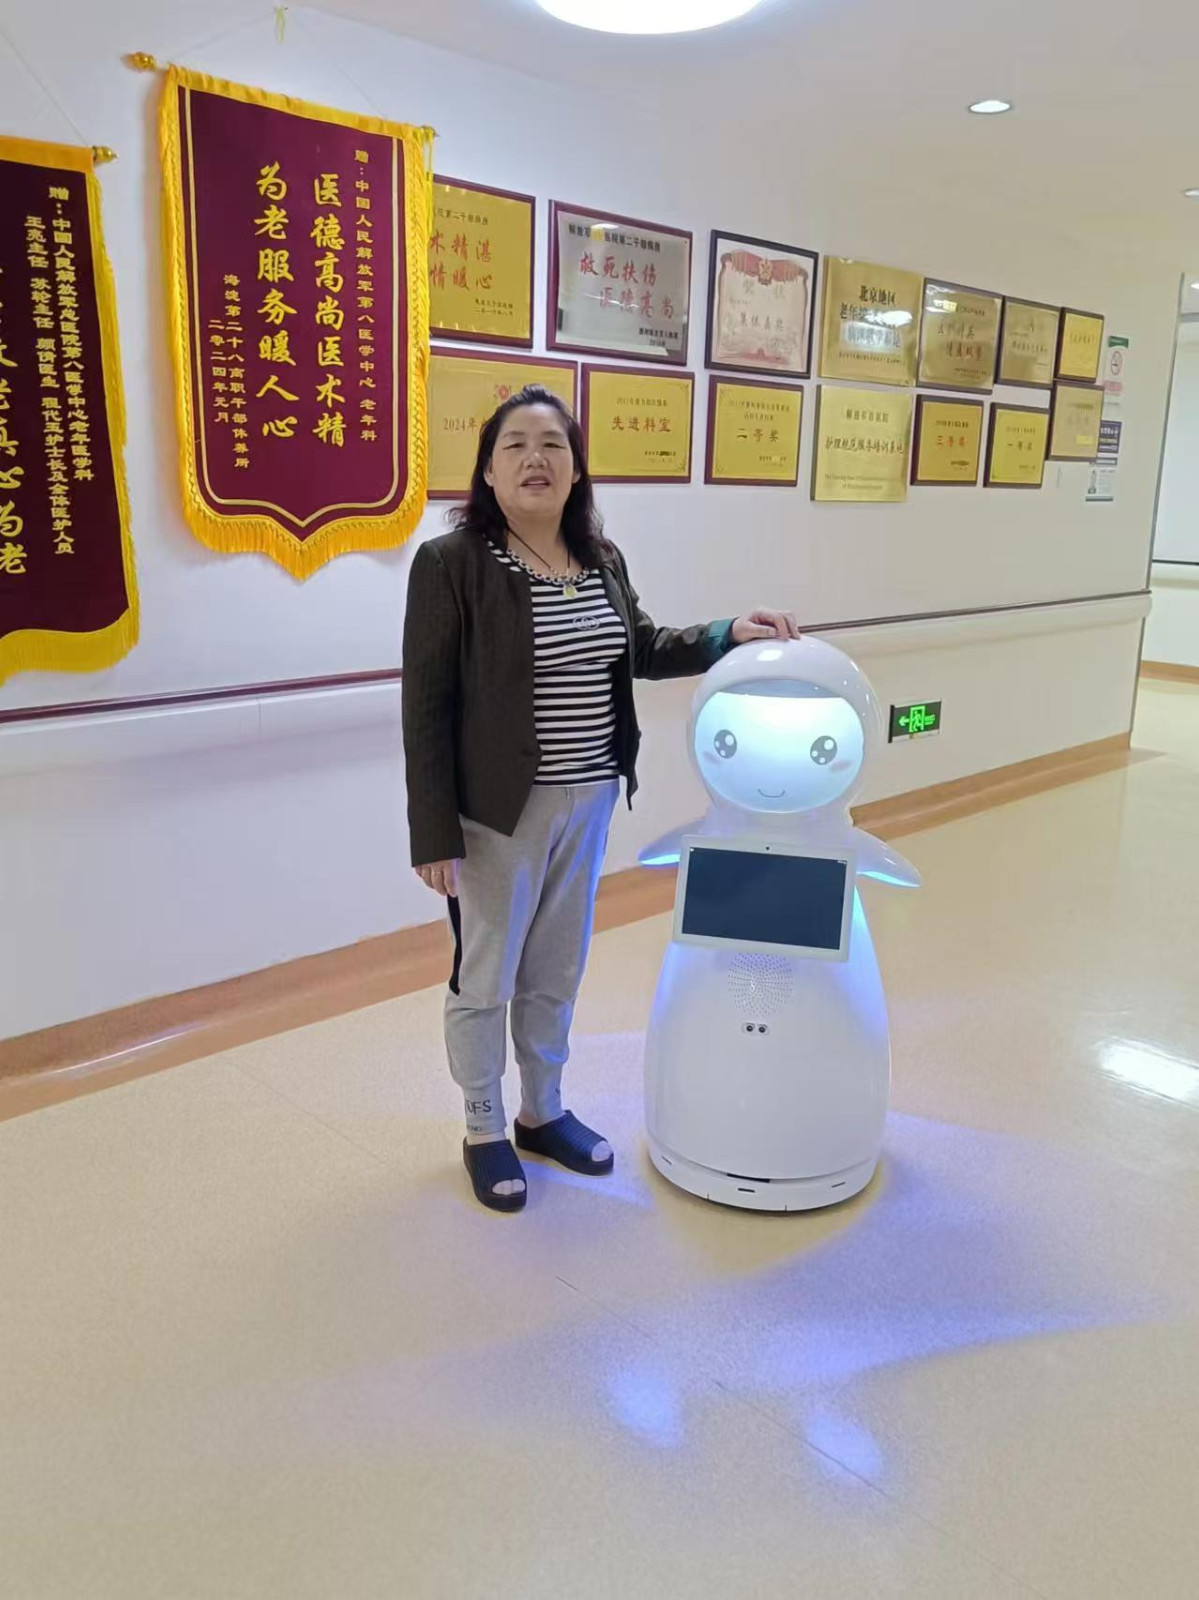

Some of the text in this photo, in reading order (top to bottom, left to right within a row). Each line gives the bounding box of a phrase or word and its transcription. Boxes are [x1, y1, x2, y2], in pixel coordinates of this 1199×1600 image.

[579, 251, 658, 286] 救死扶伤
[254, 160, 300, 438] 为老服务暖人心
[310, 173, 347, 447] 医德高尚医术精
[443, 418, 485, 432] 2024年
[612, 415, 671, 433] 先进科室
